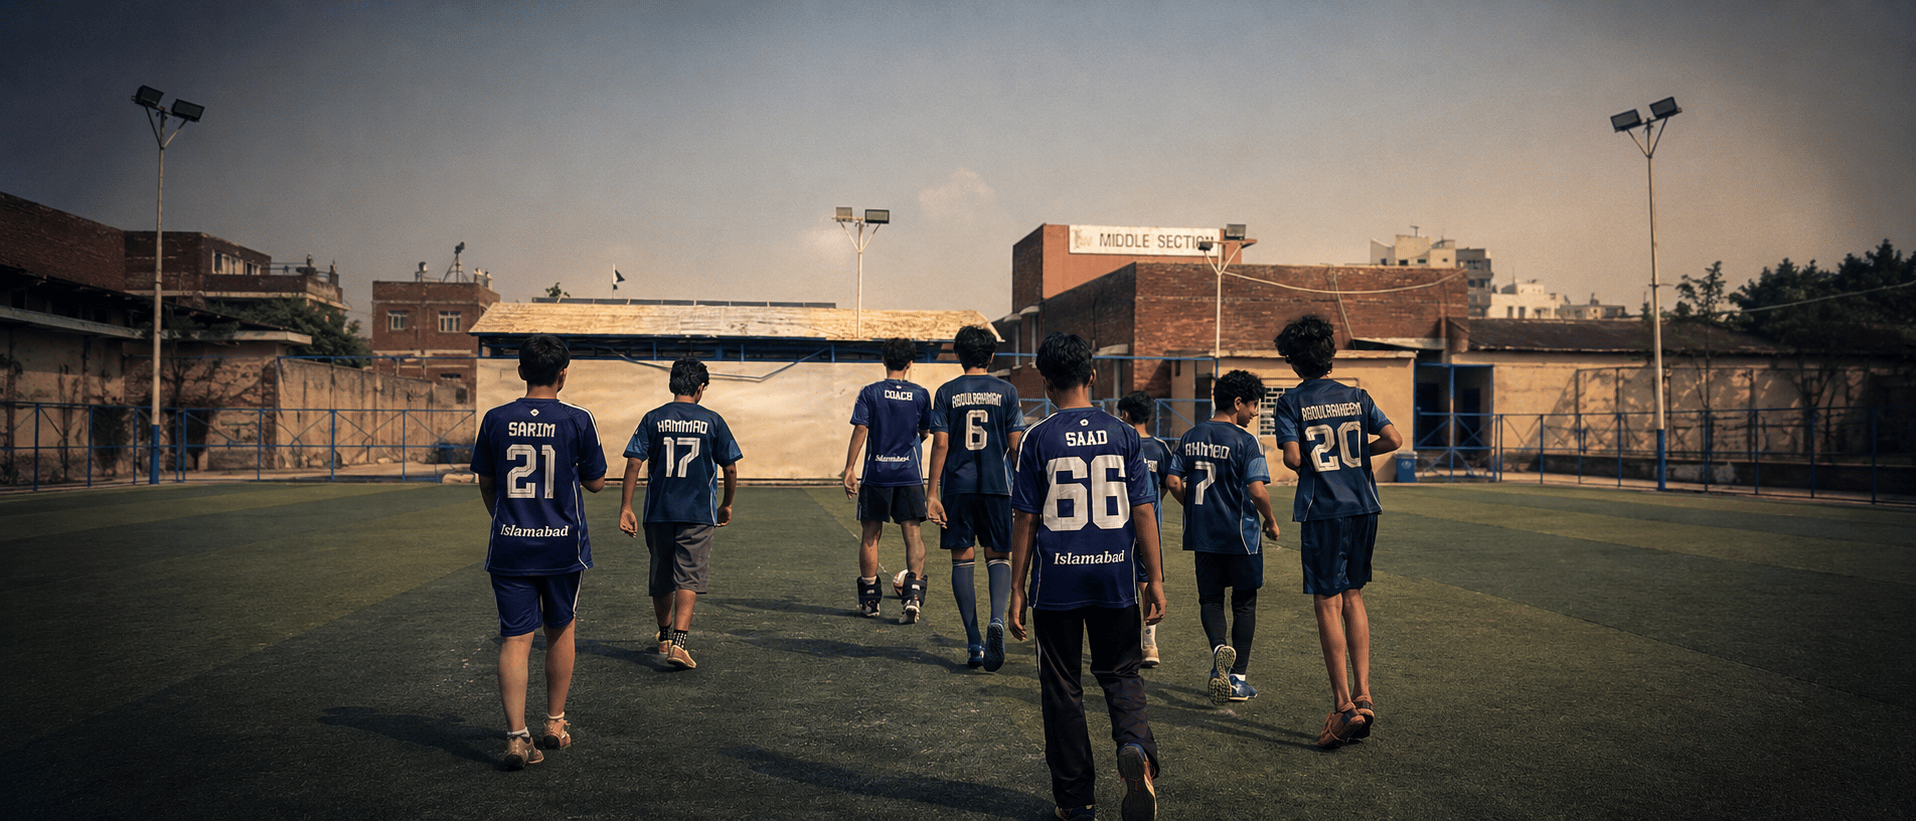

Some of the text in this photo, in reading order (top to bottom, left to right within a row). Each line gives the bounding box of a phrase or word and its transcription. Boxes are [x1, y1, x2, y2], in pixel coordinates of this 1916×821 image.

[1099, 233, 1150, 248] MIDDLE
[508, 421, 556, 437] SARIM
[657, 419, 708, 434] HAMMAD
[965, 409, 988, 451] 6
[1065, 430, 1109, 447] SAAD
[663, 436, 701, 478] 17
[1304, 420, 1362, 472] 20
[506, 443, 556, 499] 21
[1194, 461, 1217, 505] 7
[1043, 454, 1131, 532] 66
[500, 523, 569, 537] Islamabad
[1053, 550, 1125, 565] Islamabad
